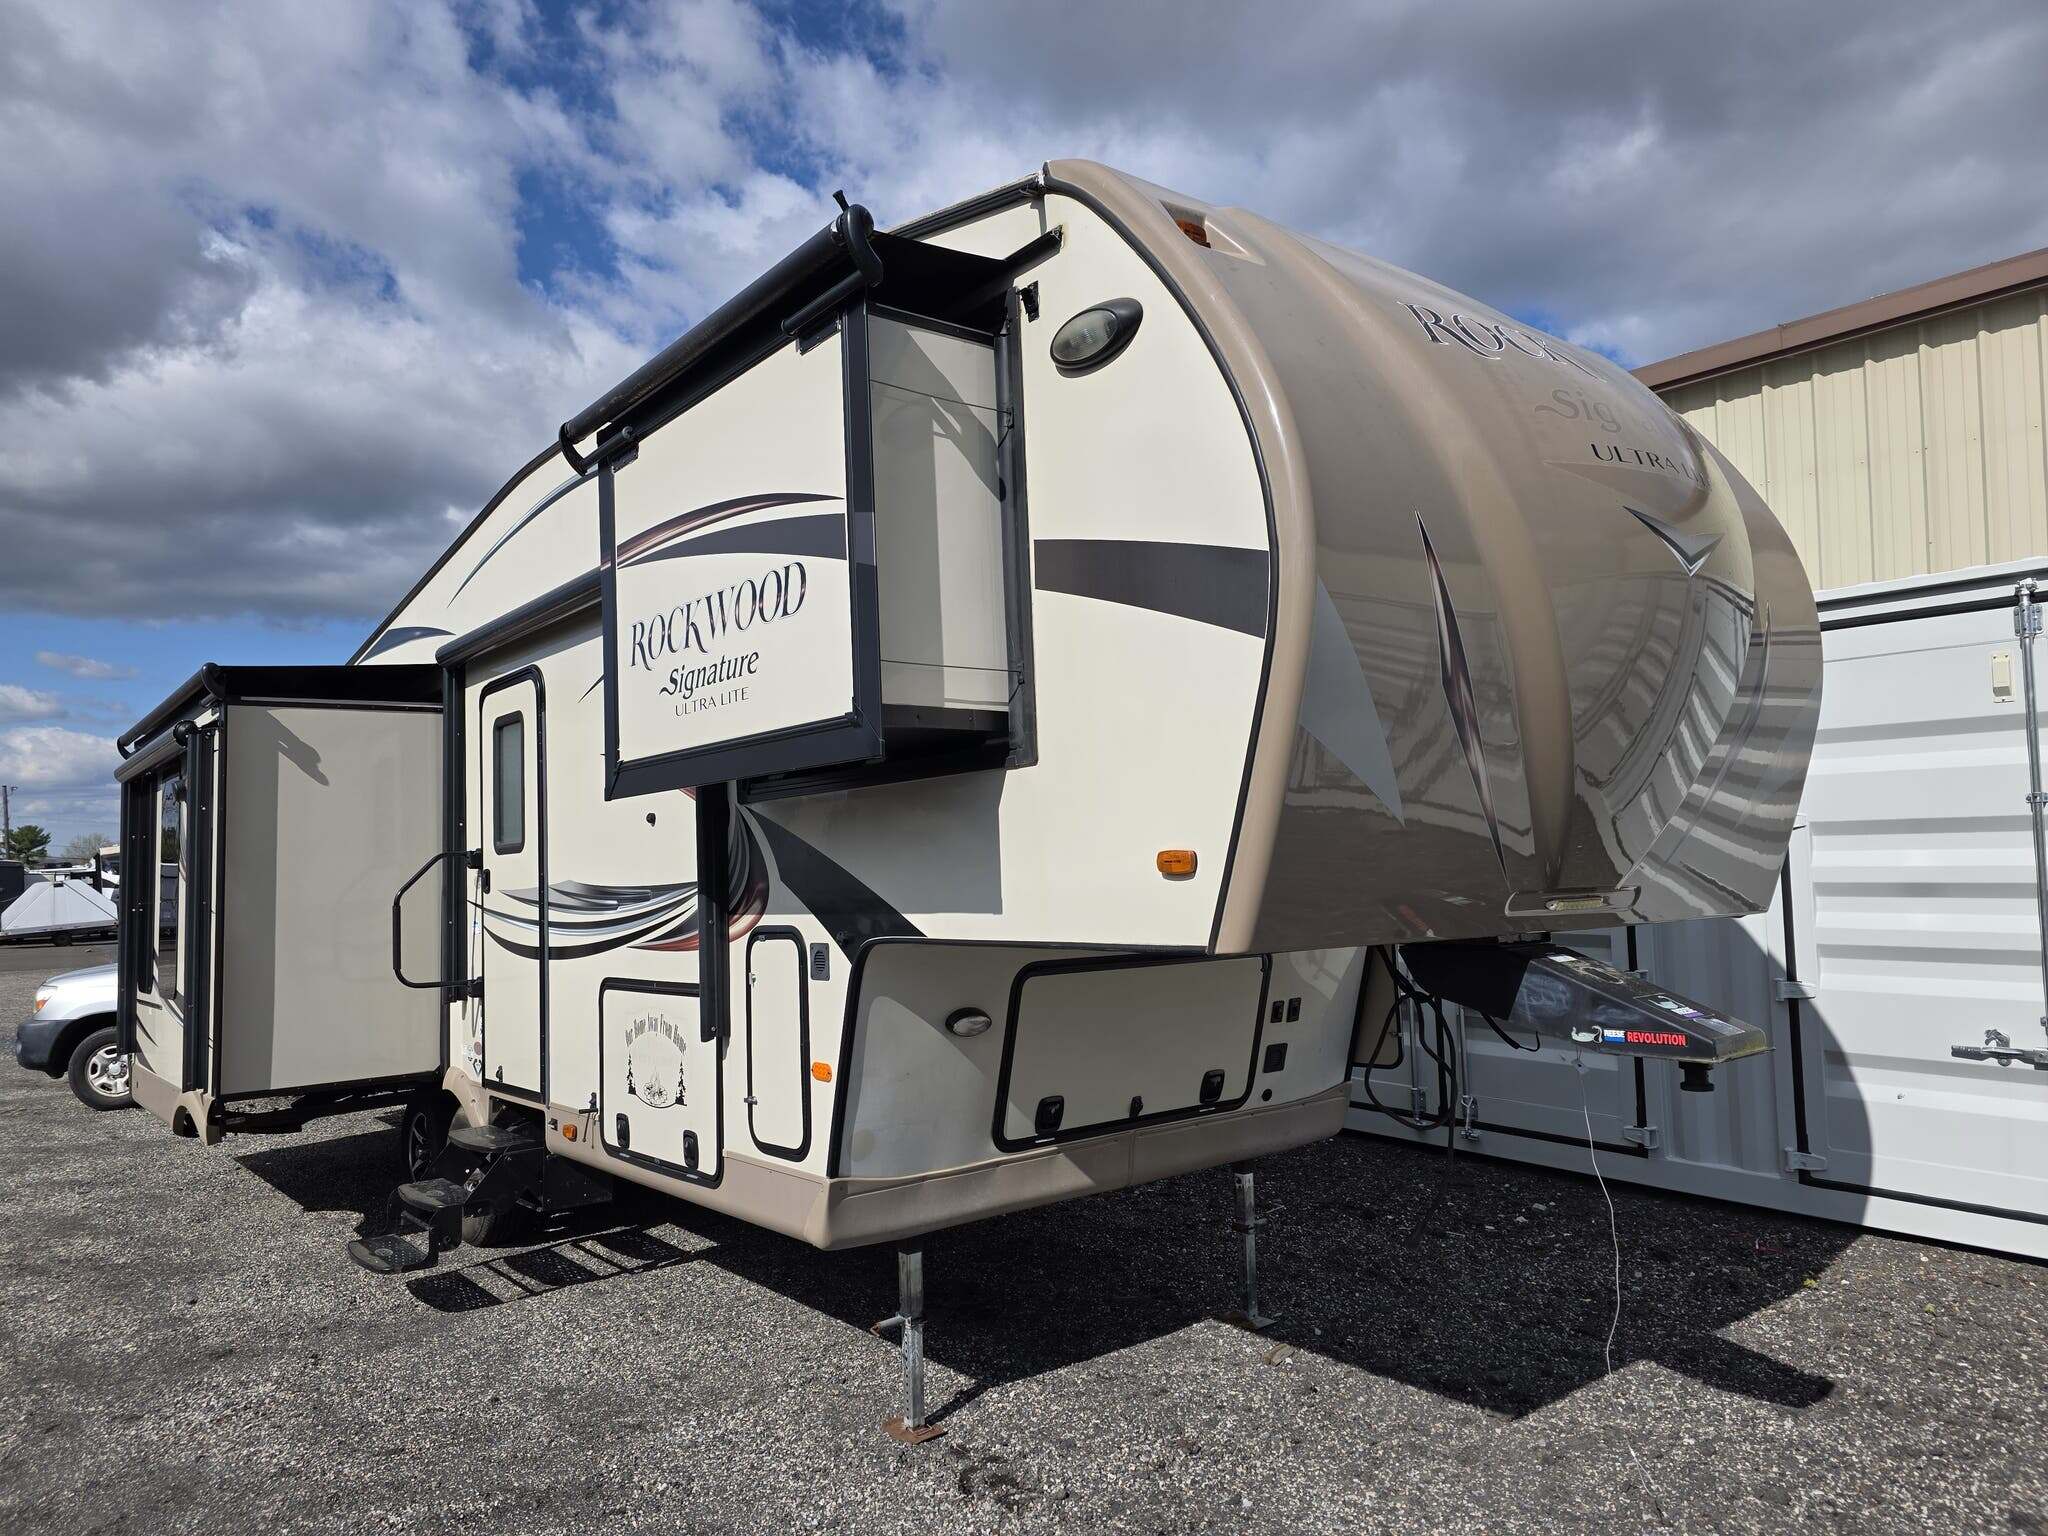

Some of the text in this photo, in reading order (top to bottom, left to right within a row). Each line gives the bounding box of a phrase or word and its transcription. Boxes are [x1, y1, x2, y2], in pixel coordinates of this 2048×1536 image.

[1590, 443, 1680, 474] ULTRA
[630, 561, 807, 672] ROCKWOOD
[659, 651, 760, 700] Signature
[675, 686, 750, 717] ULTRA LITE
[1603, 1029, 1625, 1038] REESE
[1626, 1031, 1687, 1046] REVOLUTION
